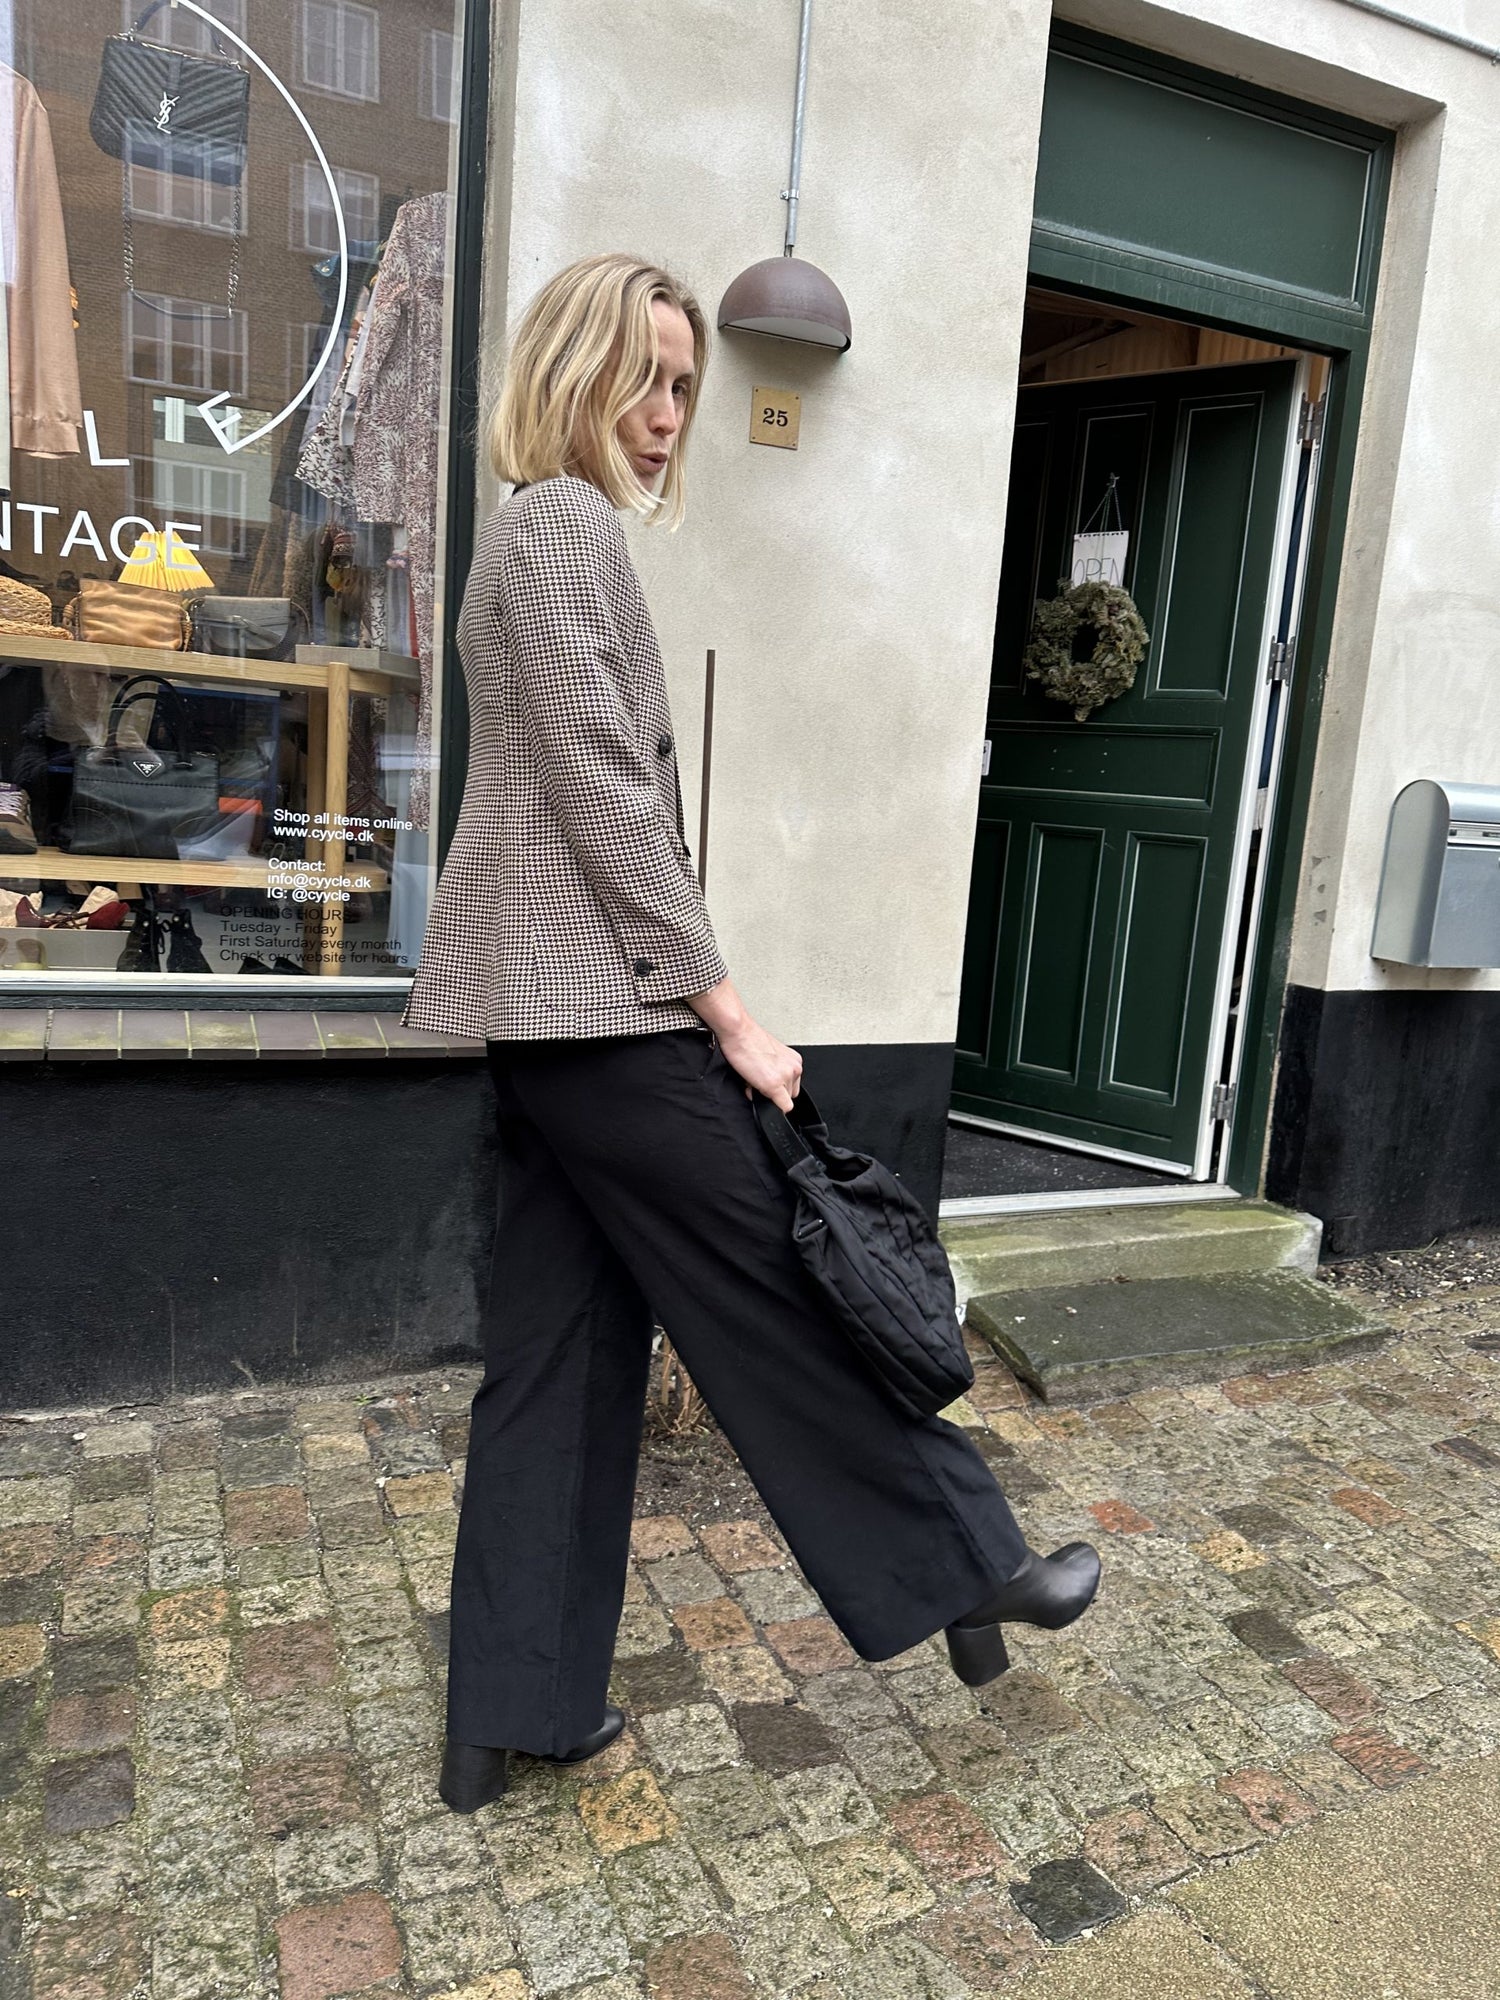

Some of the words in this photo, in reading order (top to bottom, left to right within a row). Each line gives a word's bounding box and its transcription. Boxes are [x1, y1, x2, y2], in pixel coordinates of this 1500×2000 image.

[762, 407, 789, 427] 25
[0, 500, 202, 571] TAGE
[1073, 557, 1121, 588] OPEN
[273, 808, 311, 826] Shop
[313, 812, 330, 825] all
[333, 813, 370, 828] items
[373, 816, 413, 831] online
[273, 825, 375, 843] www.cyycle.dk
[268, 857, 326, 872] Contact:
[267, 872, 372, 889] info@cyycle.dk
[266, 886, 288, 899] IG:
[292, 887, 351, 903] @cyycle
[220, 905, 293, 920] OPENING
[220, 920, 281, 936] Tuesday
[295, 922, 338, 938] Friday
[219, 934, 251, 948] First
[254, 935, 316, 951] Saturday
[320, 939, 358, 953] every
[361, 939, 402, 952] month
[219, 949, 264, 962] Check
[268, 952, 292, 963] our
[295, 951, 346, 964] website
[350, 951, 369, 964] for
[371, 952, 409, 965] hours
